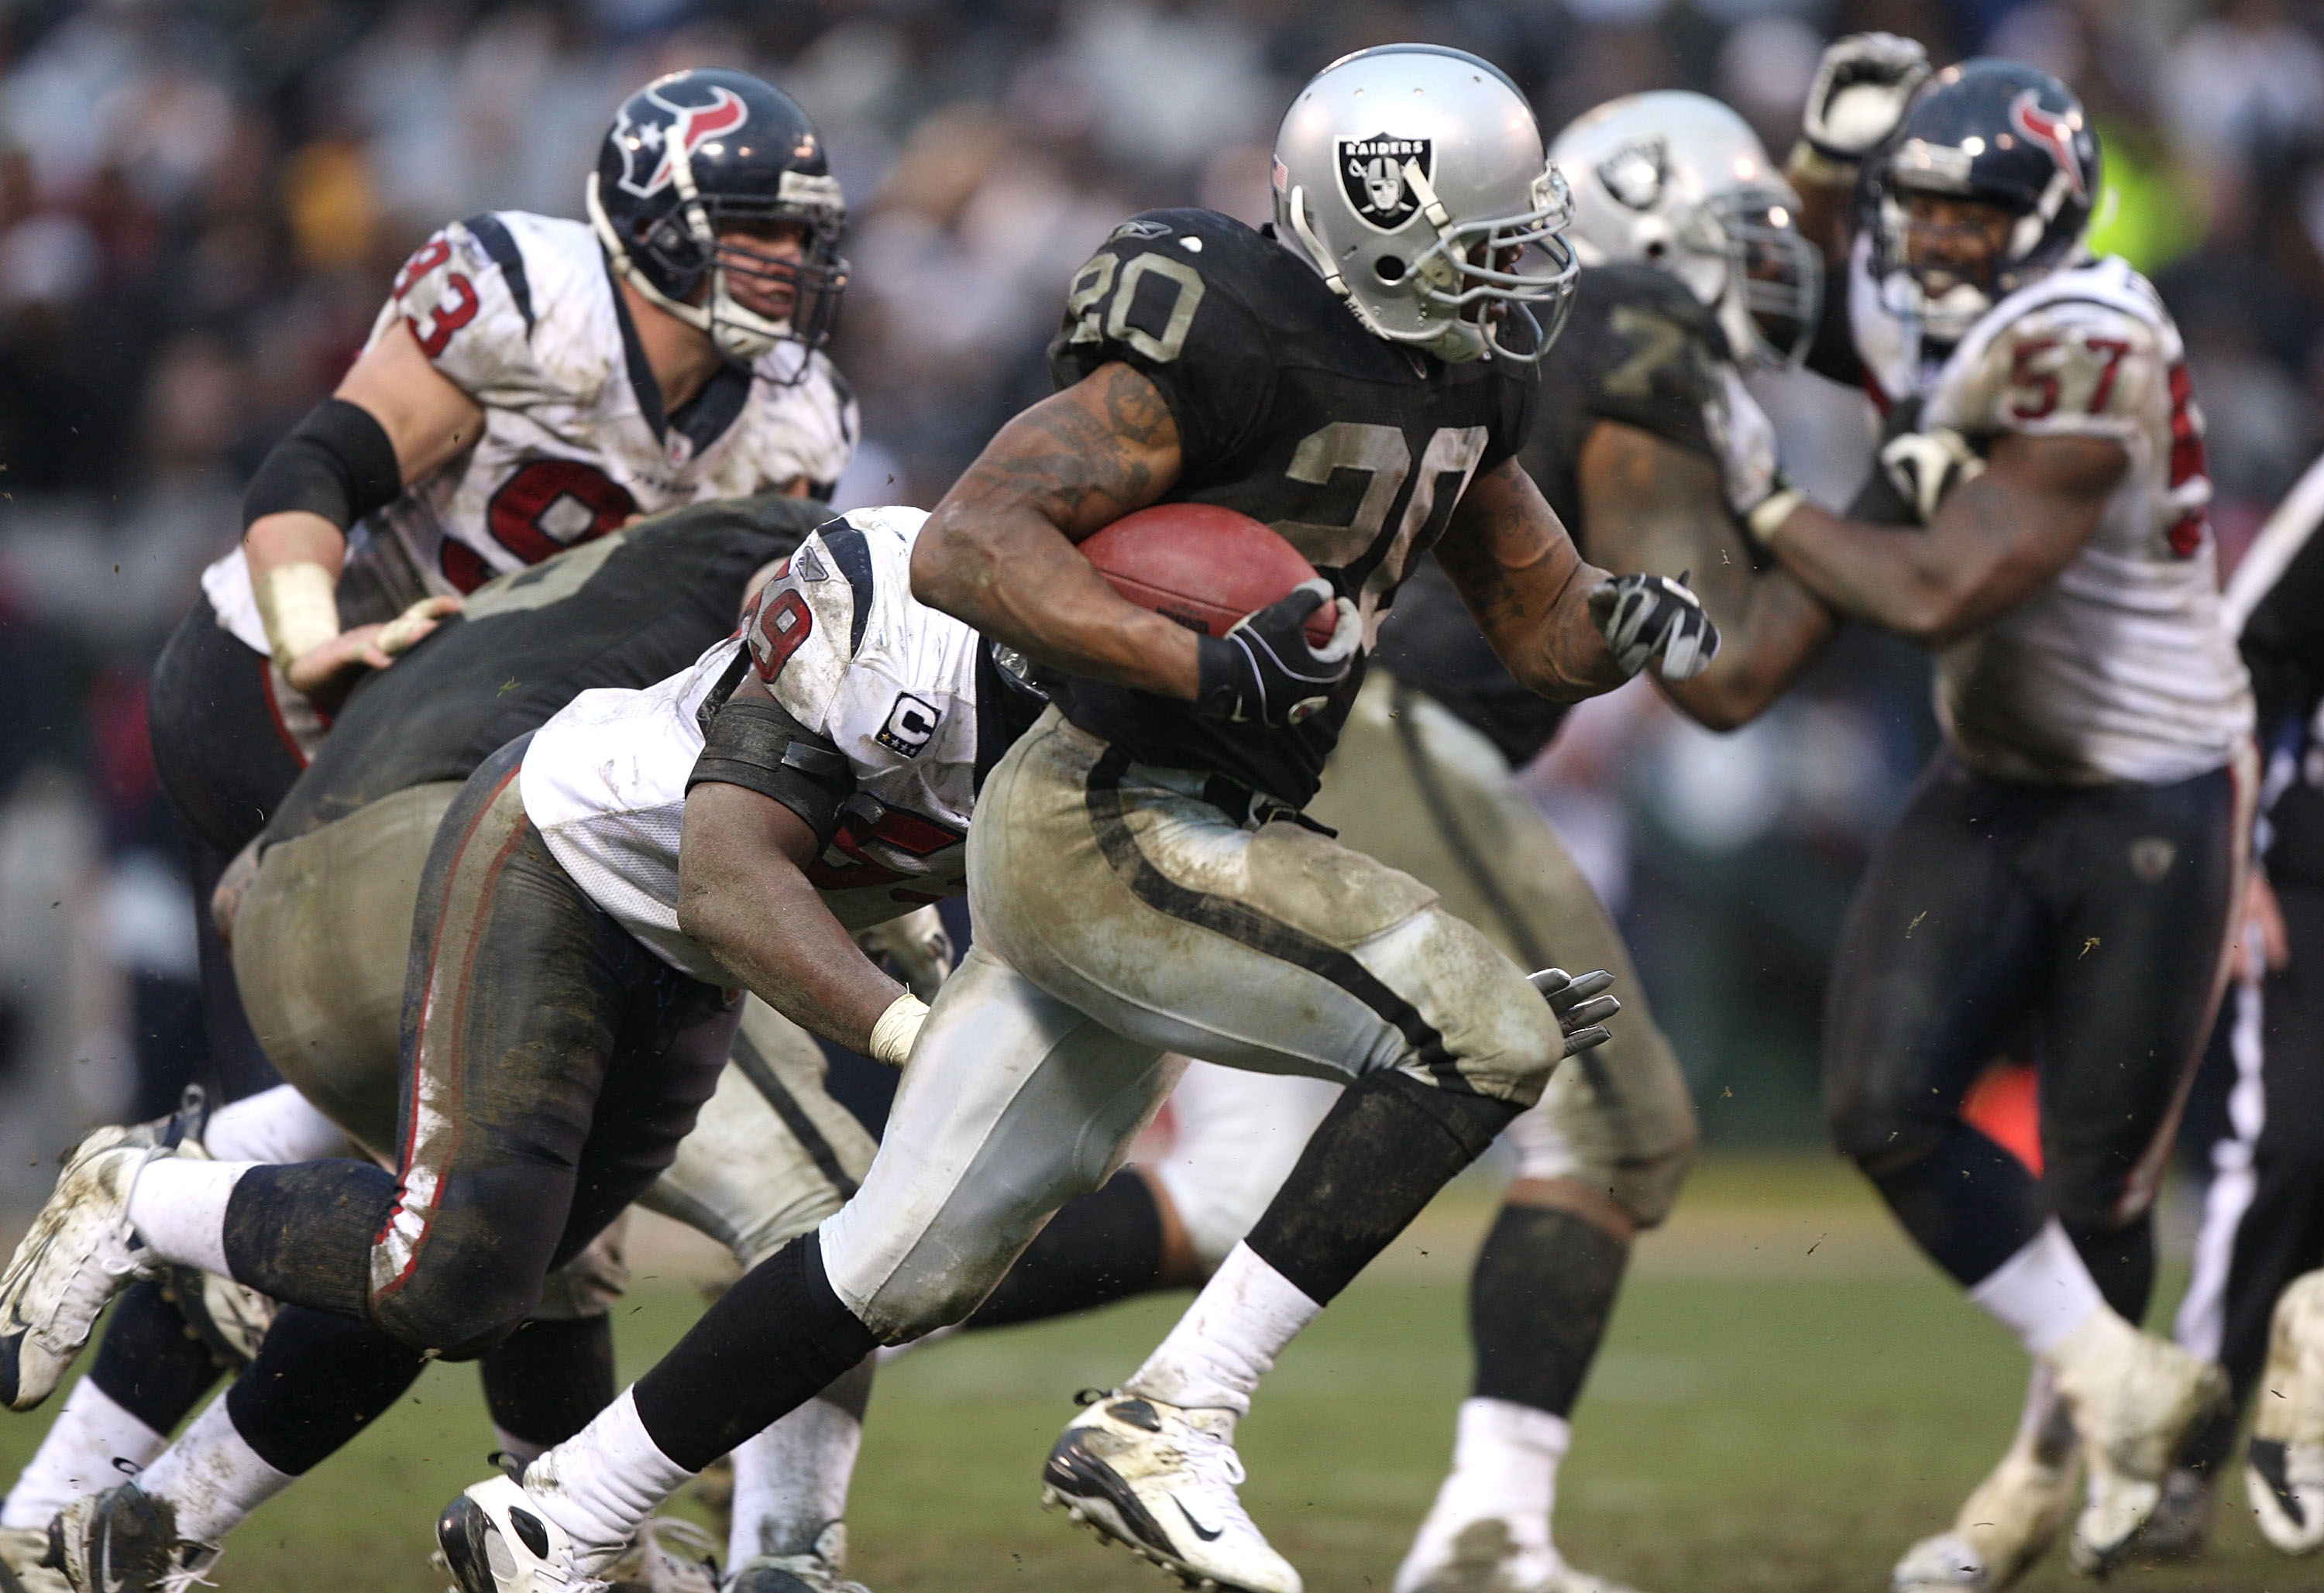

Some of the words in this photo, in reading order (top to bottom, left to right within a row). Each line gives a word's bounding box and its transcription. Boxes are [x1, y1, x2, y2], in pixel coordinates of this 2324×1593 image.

[1345, 140, 1425, 156] RAIDERS
[1067, 250, 1206, 364] 20
[2011, 338, 2133, 420] 57
[887, 696, 937, 746] C
